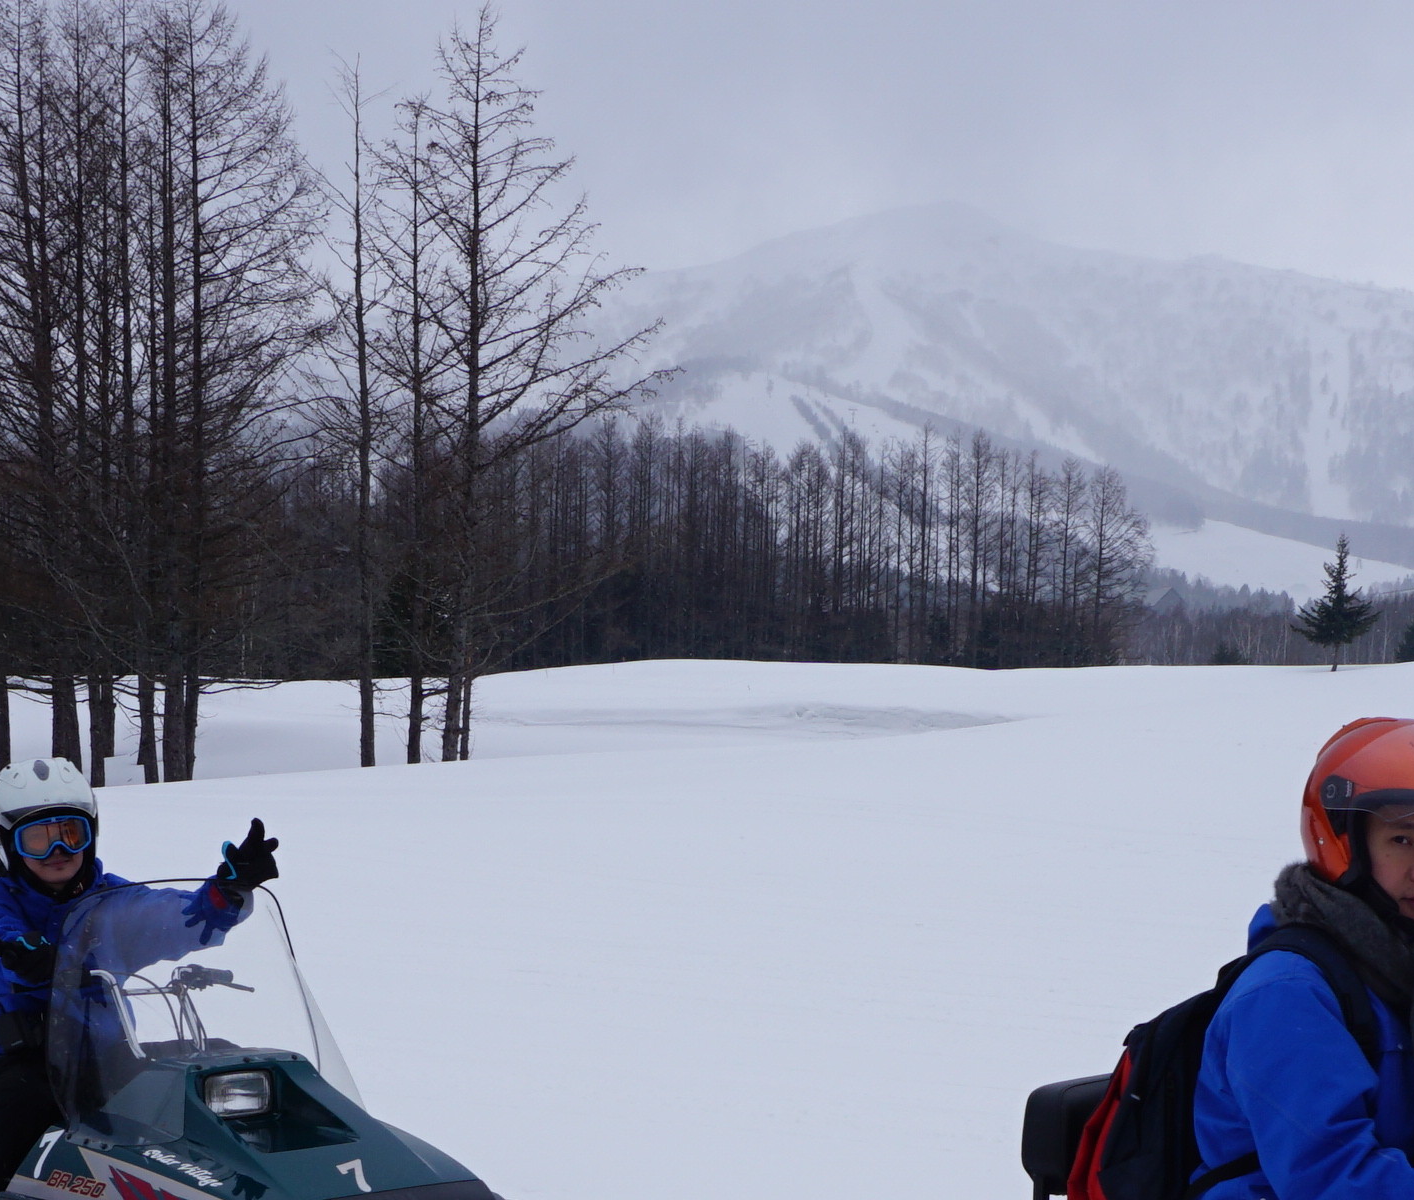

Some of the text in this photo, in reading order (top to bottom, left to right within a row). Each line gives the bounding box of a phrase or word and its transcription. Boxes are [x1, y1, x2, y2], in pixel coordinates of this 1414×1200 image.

[33, 1129, 65, 1179] 7
[142, 1149, 224, 1188] Polar Village
[46, 1168, 107, 1199] BR 250
[335, 1158, 372, 1193] 7
